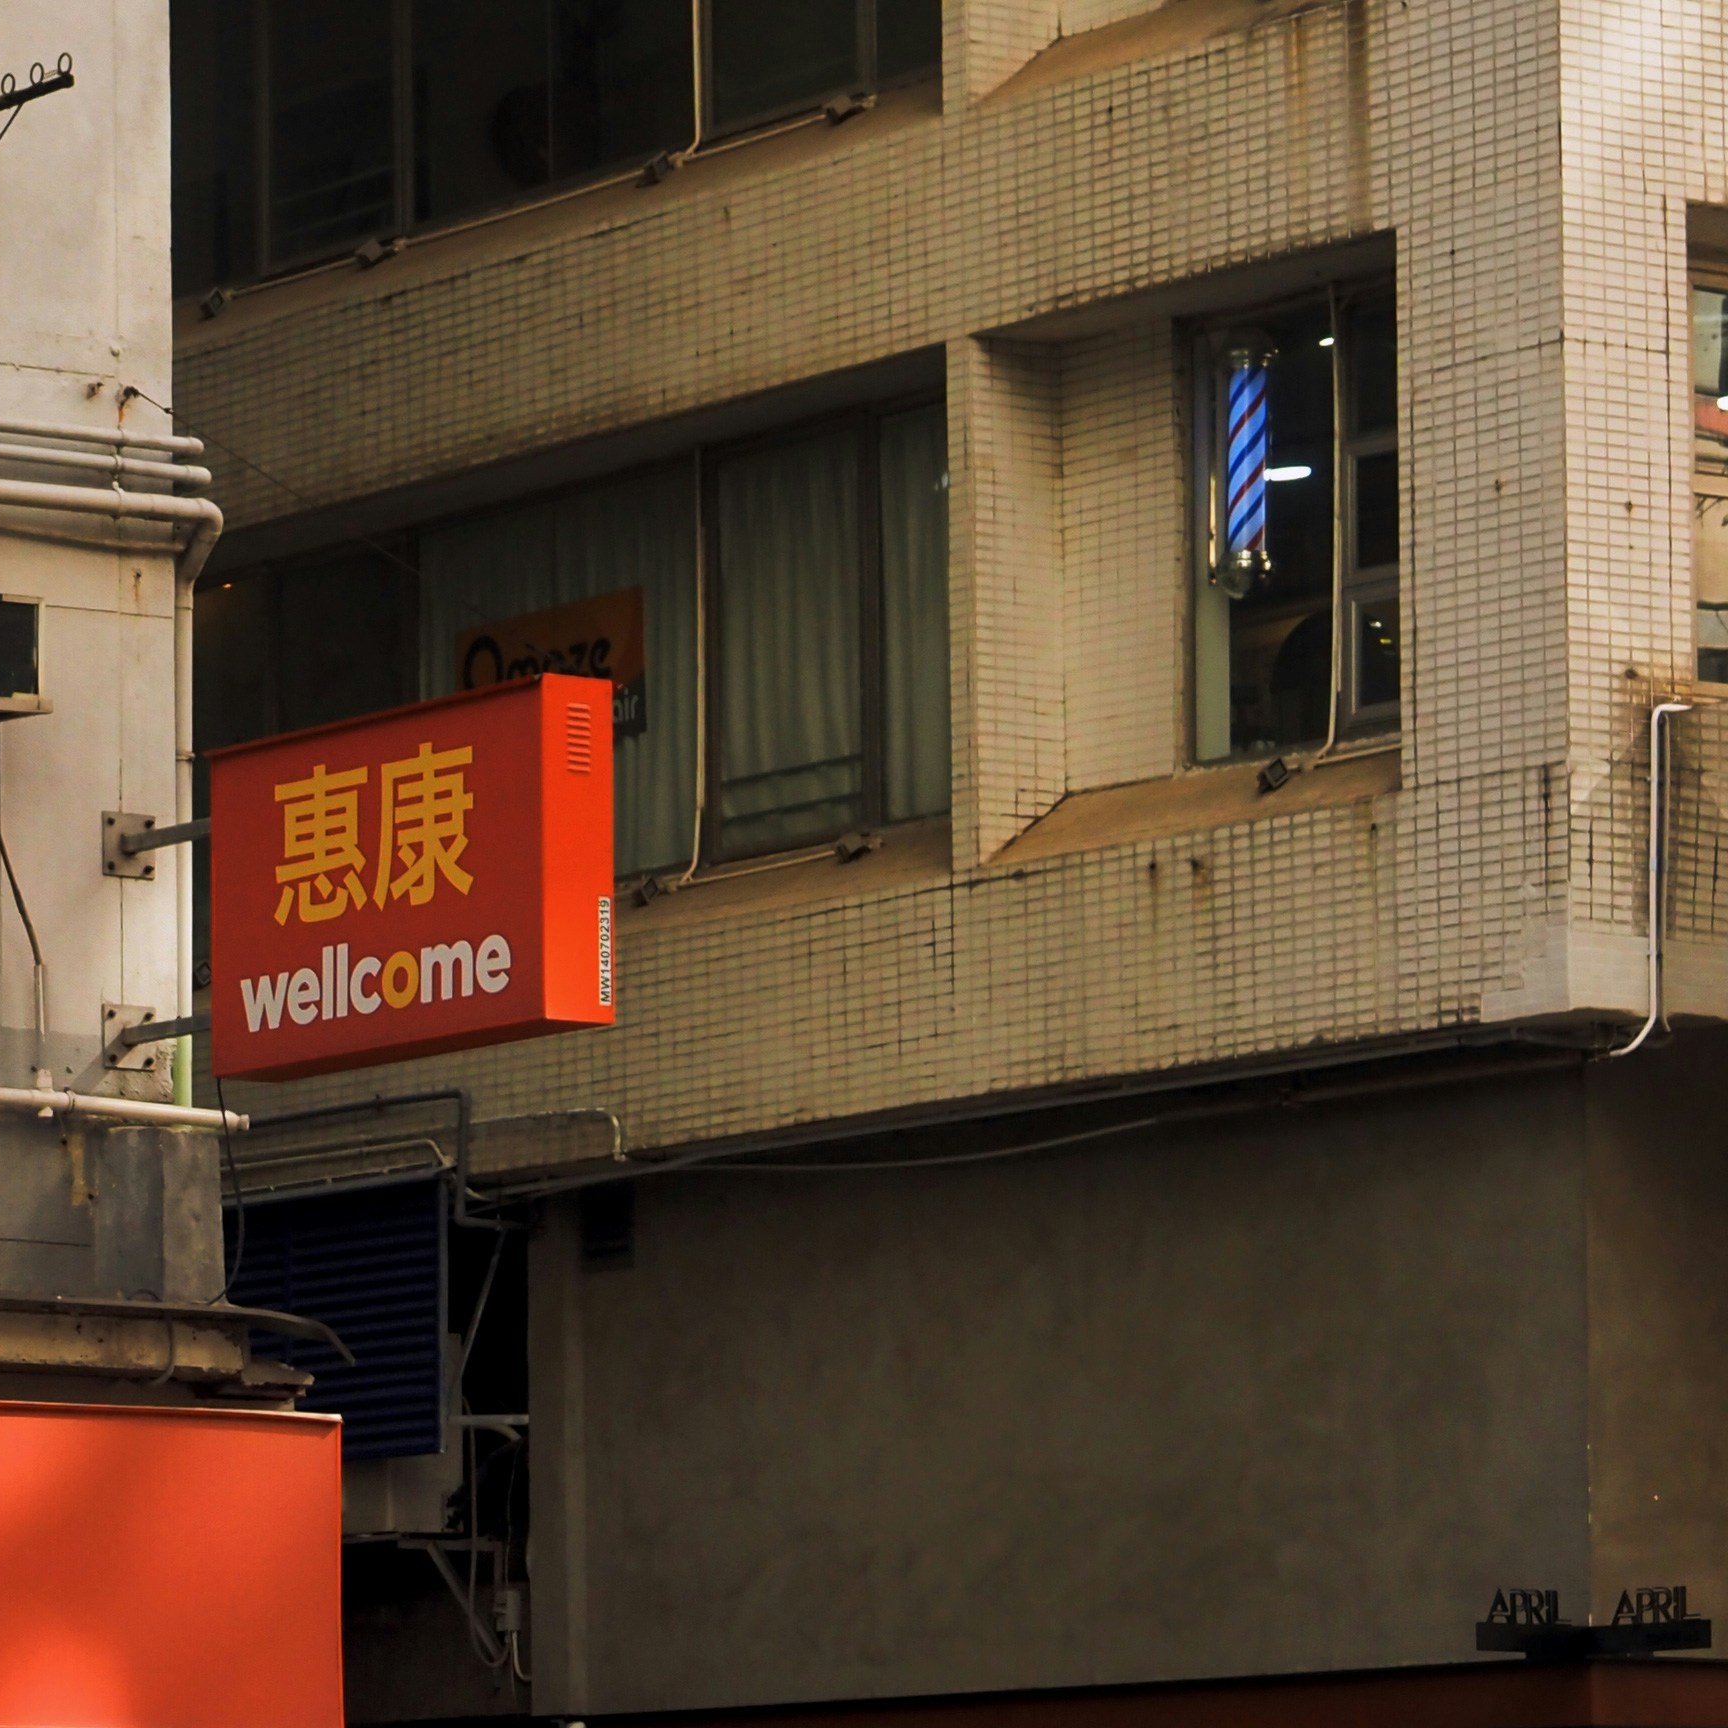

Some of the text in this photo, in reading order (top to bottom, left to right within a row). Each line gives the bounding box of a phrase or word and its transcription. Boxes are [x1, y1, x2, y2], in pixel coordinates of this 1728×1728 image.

[274, 742, 474, 927] 惠康
[240, 934, 511, 1033] wellcome
[600, 899, 611, 1003] MW140702319
[1487, 1588, 1572, 1626] APRIL
[1612, 1586, 1702, 1626] APRIL
